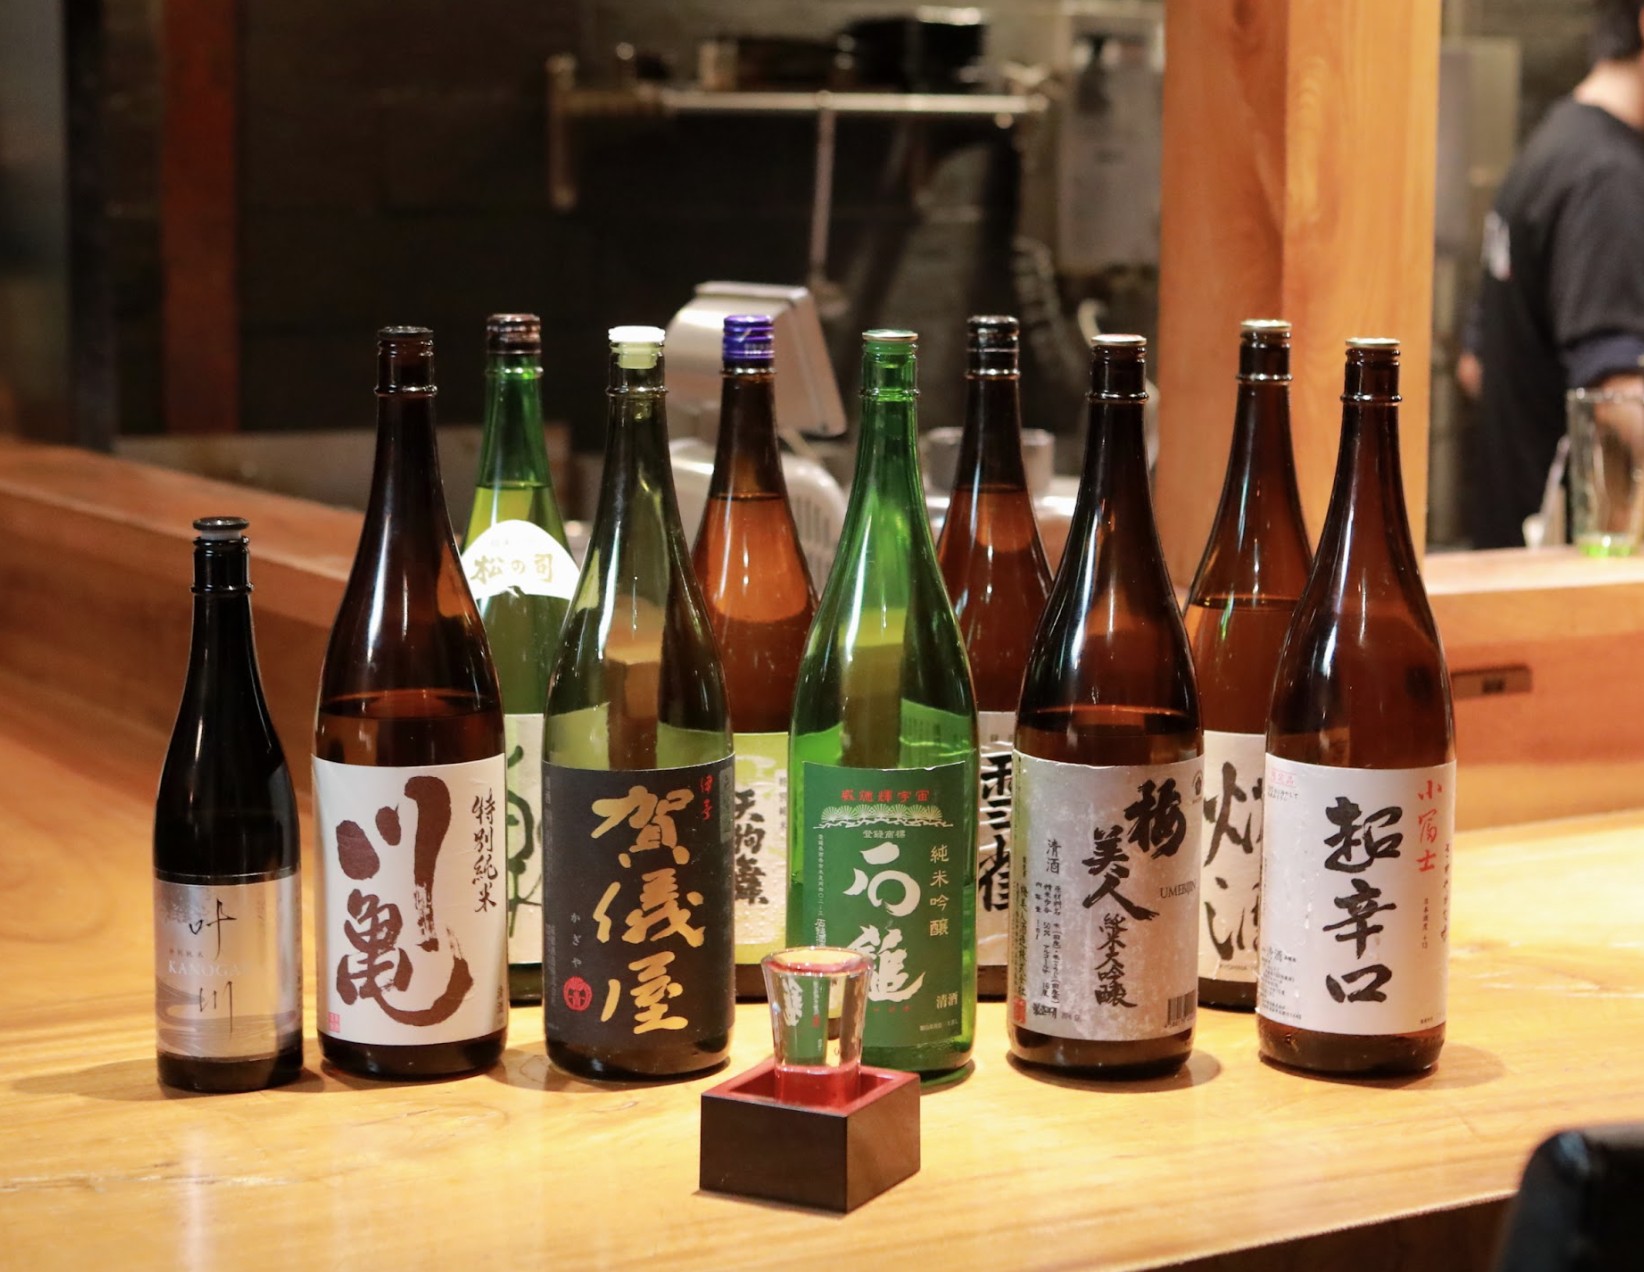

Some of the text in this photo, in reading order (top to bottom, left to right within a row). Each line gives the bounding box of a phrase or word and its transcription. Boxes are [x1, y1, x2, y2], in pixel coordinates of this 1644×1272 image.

[470, 553, 554, 584] 松の司
[471, 788, 498, 913] 特別純米
[1046, 839, 1061, 874] 清酒
[1324, 796, 1403, 1003] 超辛口
[591, 785, 704, 1034] 賀儀屋
[1094, 912, 1138, 1009] 純米大吟醸
